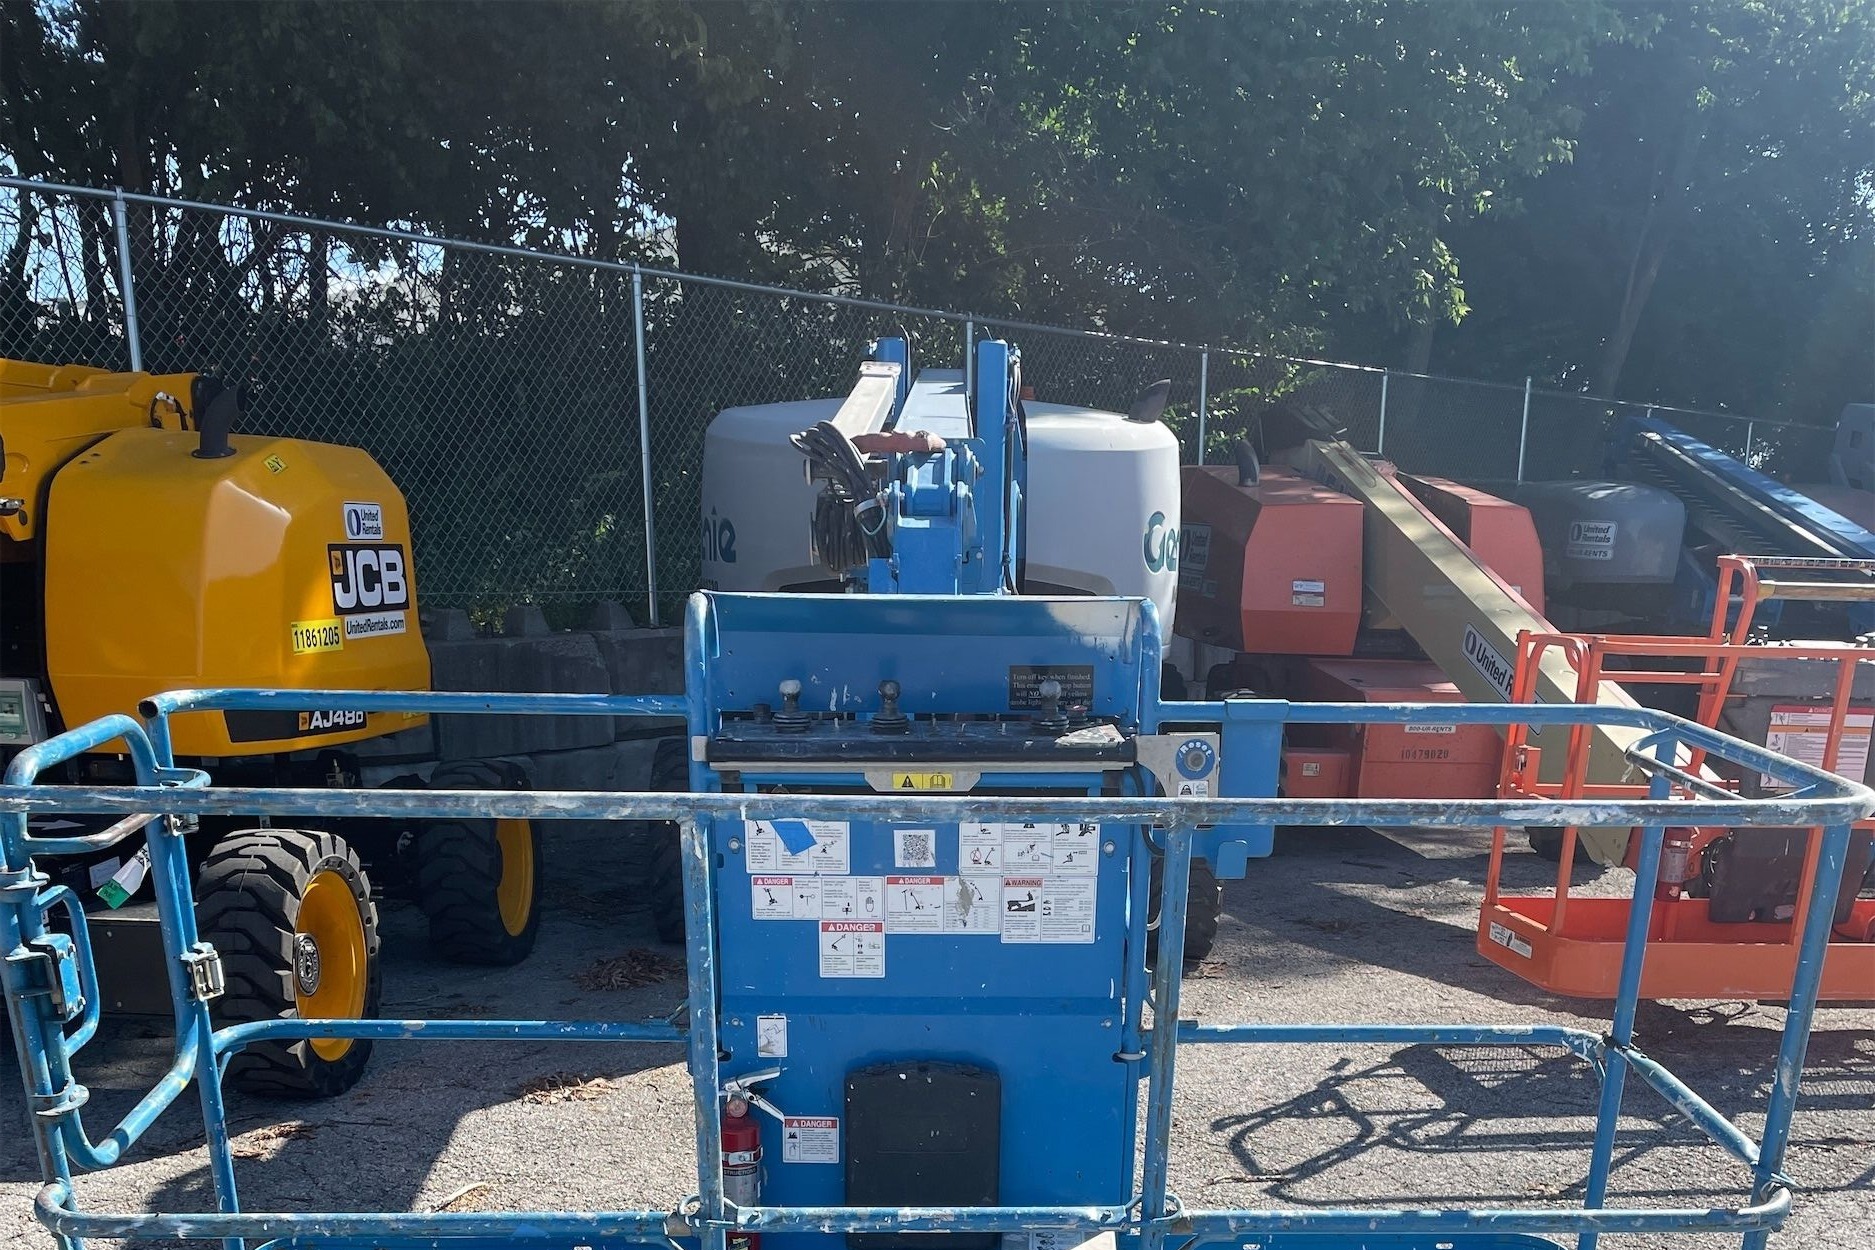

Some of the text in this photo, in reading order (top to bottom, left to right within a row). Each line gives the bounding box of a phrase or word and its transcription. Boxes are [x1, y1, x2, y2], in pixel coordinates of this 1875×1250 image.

[361, 509, 379, 521] United
[362, 522, 381, 535] Rentals
[701, 506, 736, 563] nie
[1584, 525, 1611, 534] United
[1582, 534, 1611, 543] Rentals
[334, 549, 407, 609] JCB
[346, 618, 404, 635] UnitedRentals.com
[294, 626, 340, 649] 11861205
[1476, 643, 1508, 687] United
[1180, 742, 1212, 757] Reset
[836, 923, 876, 932] DANGER
[800, 1120, 832, 1128] DANGER
[724, 1168, 757, 1176] STRUCTIONS
